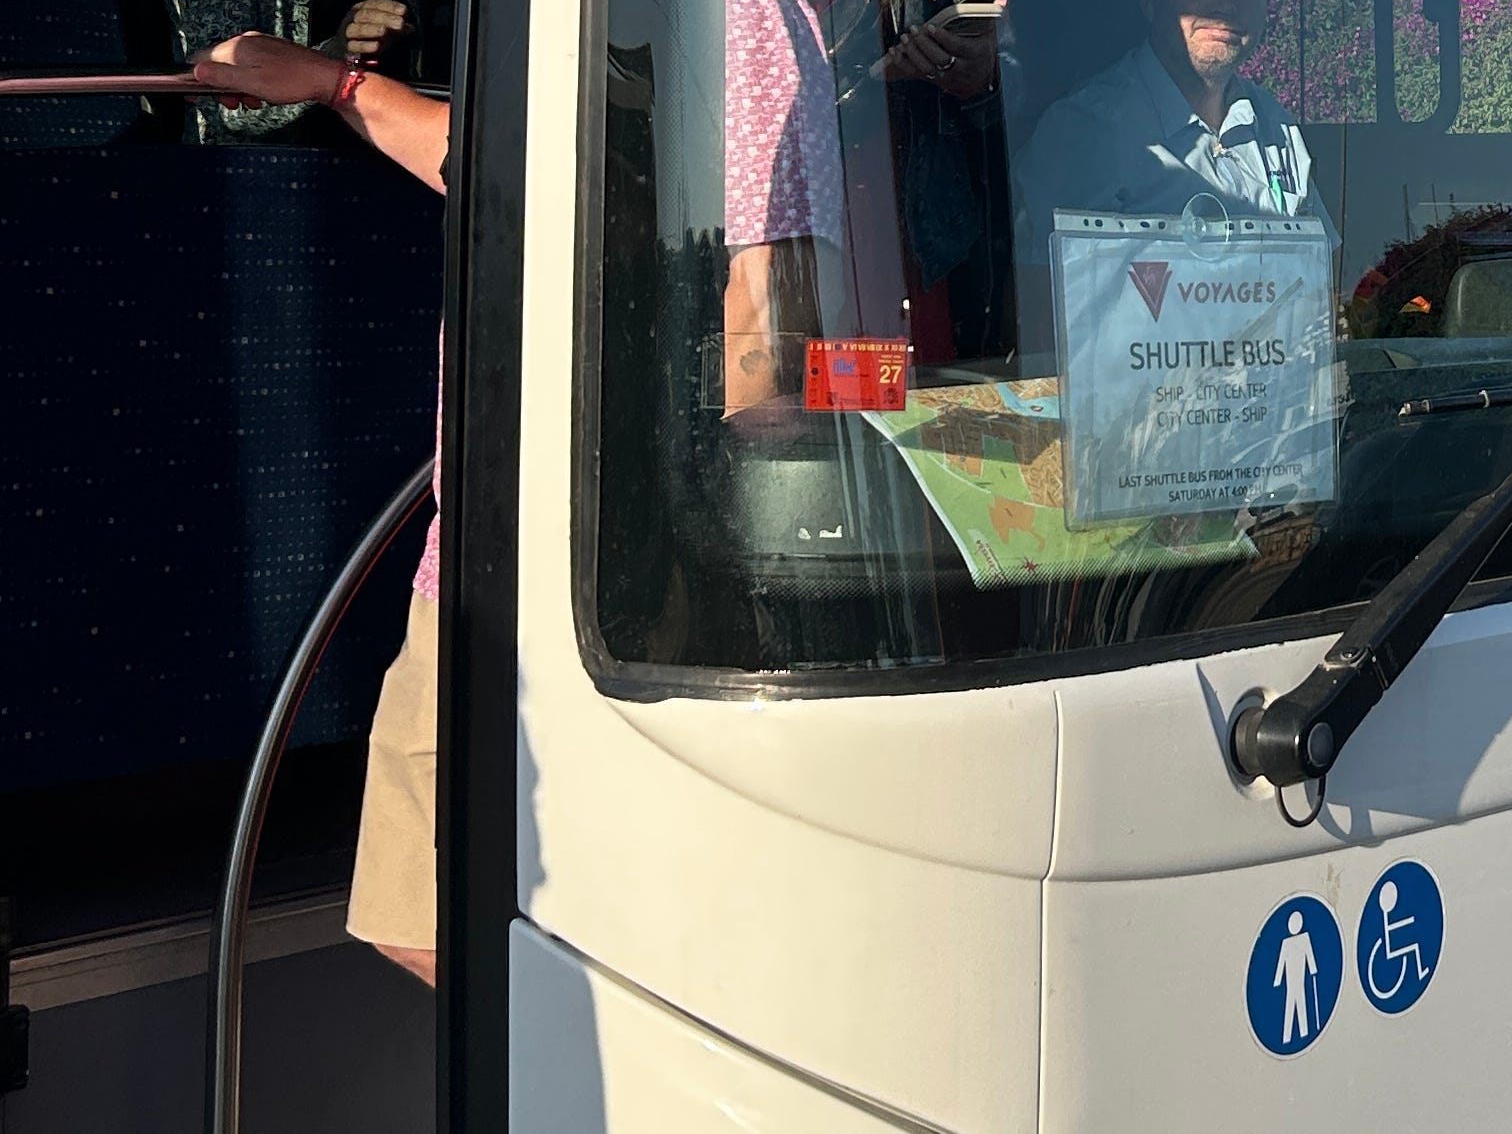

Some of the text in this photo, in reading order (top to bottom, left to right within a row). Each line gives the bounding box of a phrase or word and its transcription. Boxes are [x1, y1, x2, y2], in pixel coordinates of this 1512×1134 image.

[1177, 281, 1276, 303] VOYAGES
[1130, 338, 1285, 370] SHUTTLE BUS
[879, 365, 902, 384] 27
[1156, 385, 1184, 402] SHIP
[1196, 384, 1221, 401] CITY
[1223, 382, 1267, 399] CENTER
[1186, 407, 1232, 425] CENTER
[1242, 406, 1267, 422] SHIP
[1118, 475, 1141, 488] LAST
[1144, 471, 1186, 487] SHUTTLE
[1188, 469, 1207, 483] BUS
[1208, 468, 1233, 481] FROM
[1234, 467, 1252, 479] THE
[1168, 487, 1217, 503] SATURDAY
[1218, 486, 1230, 499] AT
